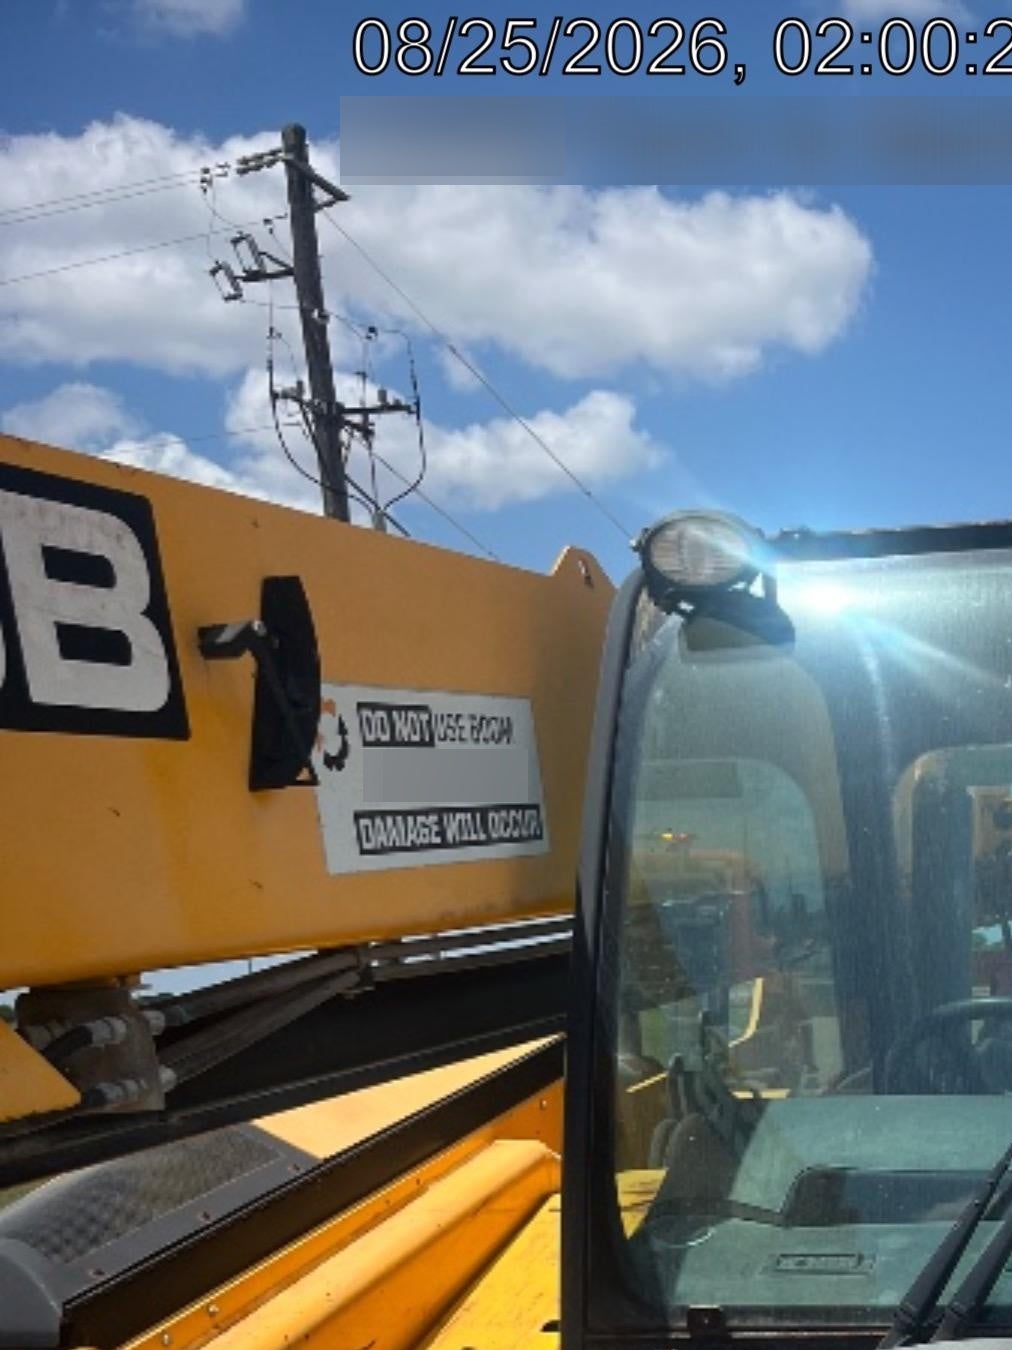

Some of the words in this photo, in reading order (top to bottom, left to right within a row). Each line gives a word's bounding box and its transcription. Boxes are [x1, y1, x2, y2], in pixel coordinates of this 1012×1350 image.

[361, 709, 391, 742] DO
[392, 710, 431, 743] NOT
[434, 713, 467, 742] USE
[359, 816, 441, 849] DAMAGE
[443, 812, 488, 843] WILL
